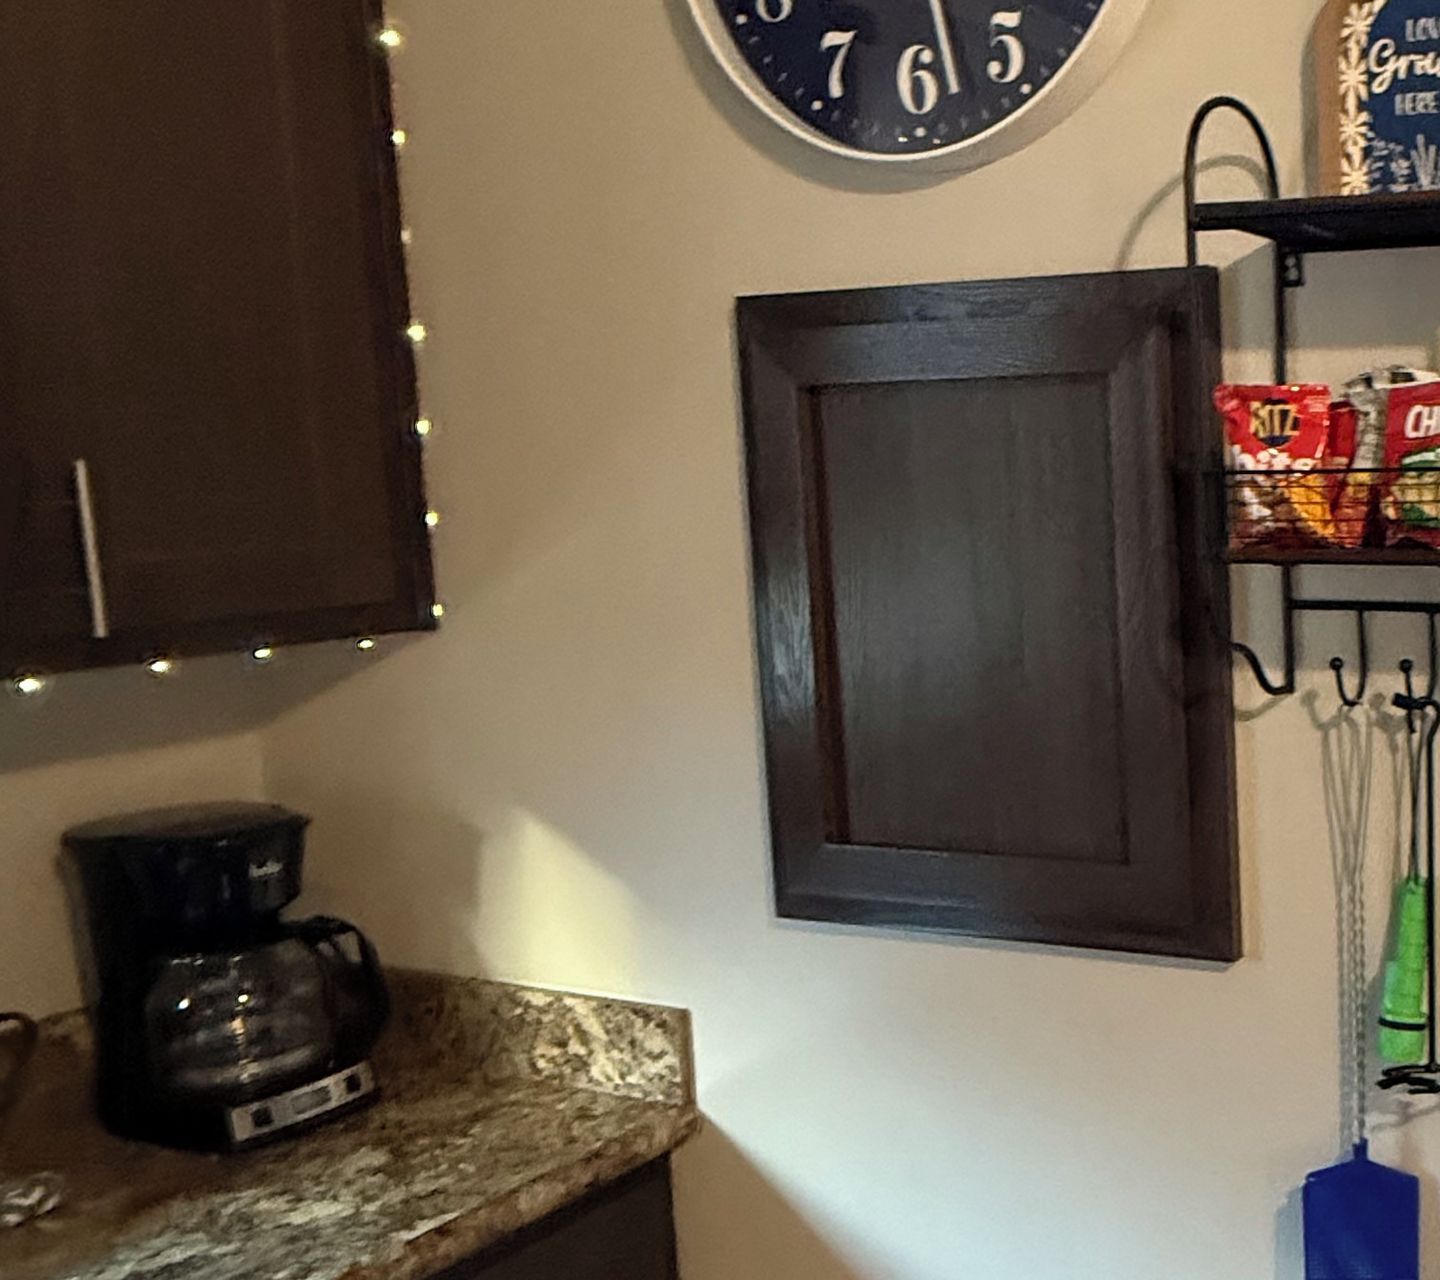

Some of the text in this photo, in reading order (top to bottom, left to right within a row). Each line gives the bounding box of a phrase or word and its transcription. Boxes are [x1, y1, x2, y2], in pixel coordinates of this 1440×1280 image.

[819, 30, 859, 99] 7
[897, 45, 939, 116] 6
[988, 11, 1025, 83] 5
[1250, 400, 1300, 439] RITZ
